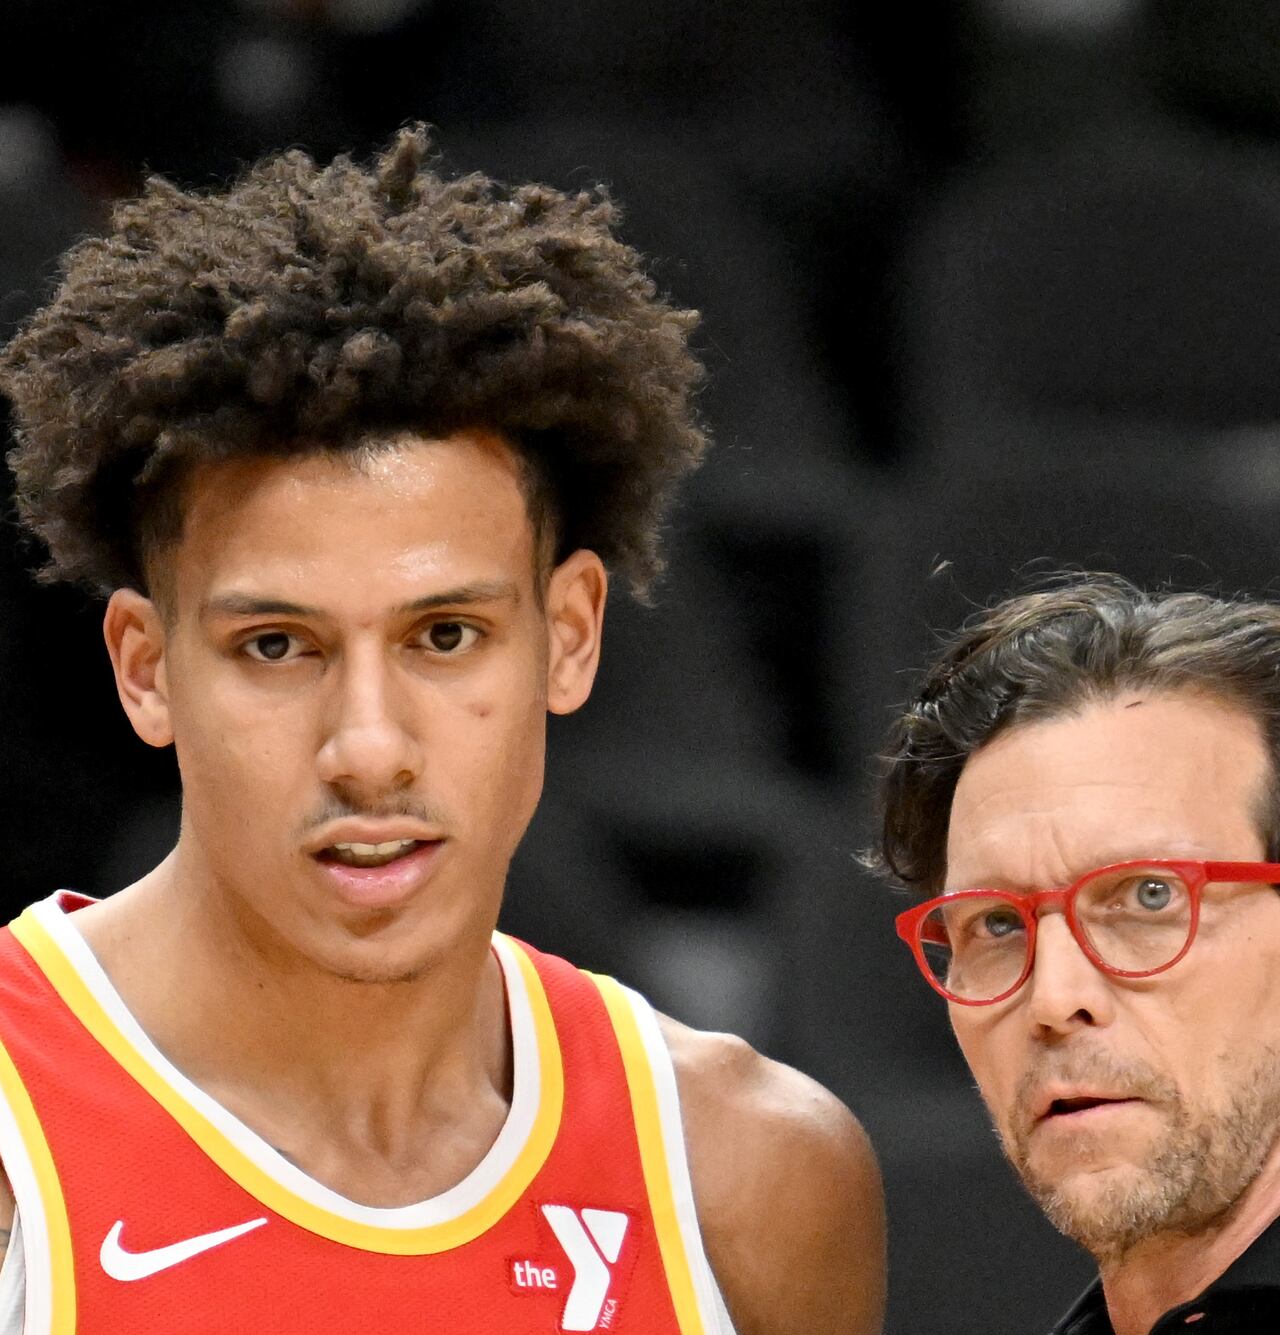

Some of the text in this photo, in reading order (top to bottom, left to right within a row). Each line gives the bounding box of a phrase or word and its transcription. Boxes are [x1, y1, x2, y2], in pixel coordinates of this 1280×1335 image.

[513, 1204, 629, 1332] the Y
[598, 1298, 617, 1329] YMCA
